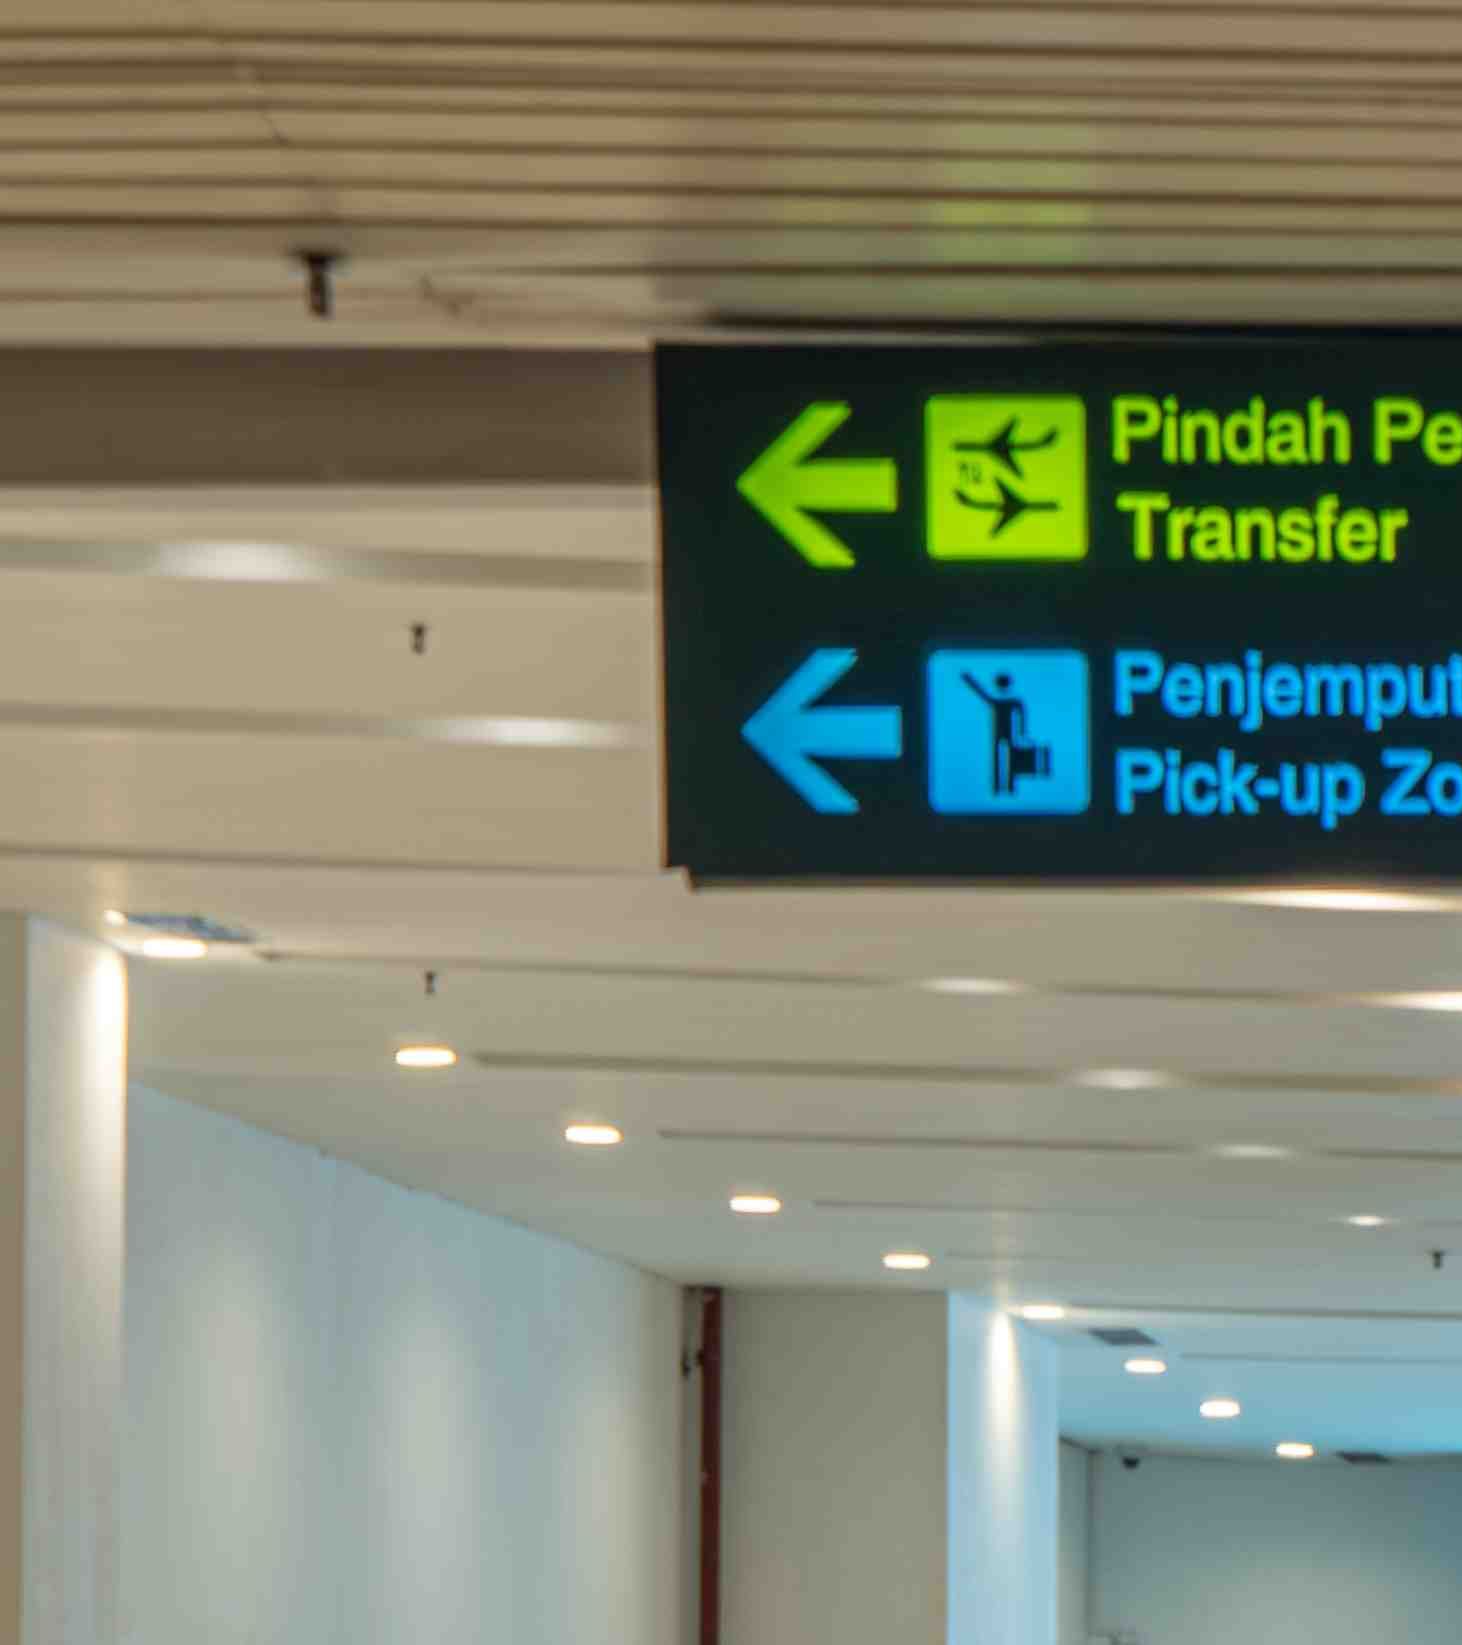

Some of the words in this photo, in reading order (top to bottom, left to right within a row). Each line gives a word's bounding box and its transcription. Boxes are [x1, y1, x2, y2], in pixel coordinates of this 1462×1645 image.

[1112, 396, 1355, 464] Pindah
[1116, 492, 1408, 562] Transfer
[1113, 750, 1366, 830] Pick-up
